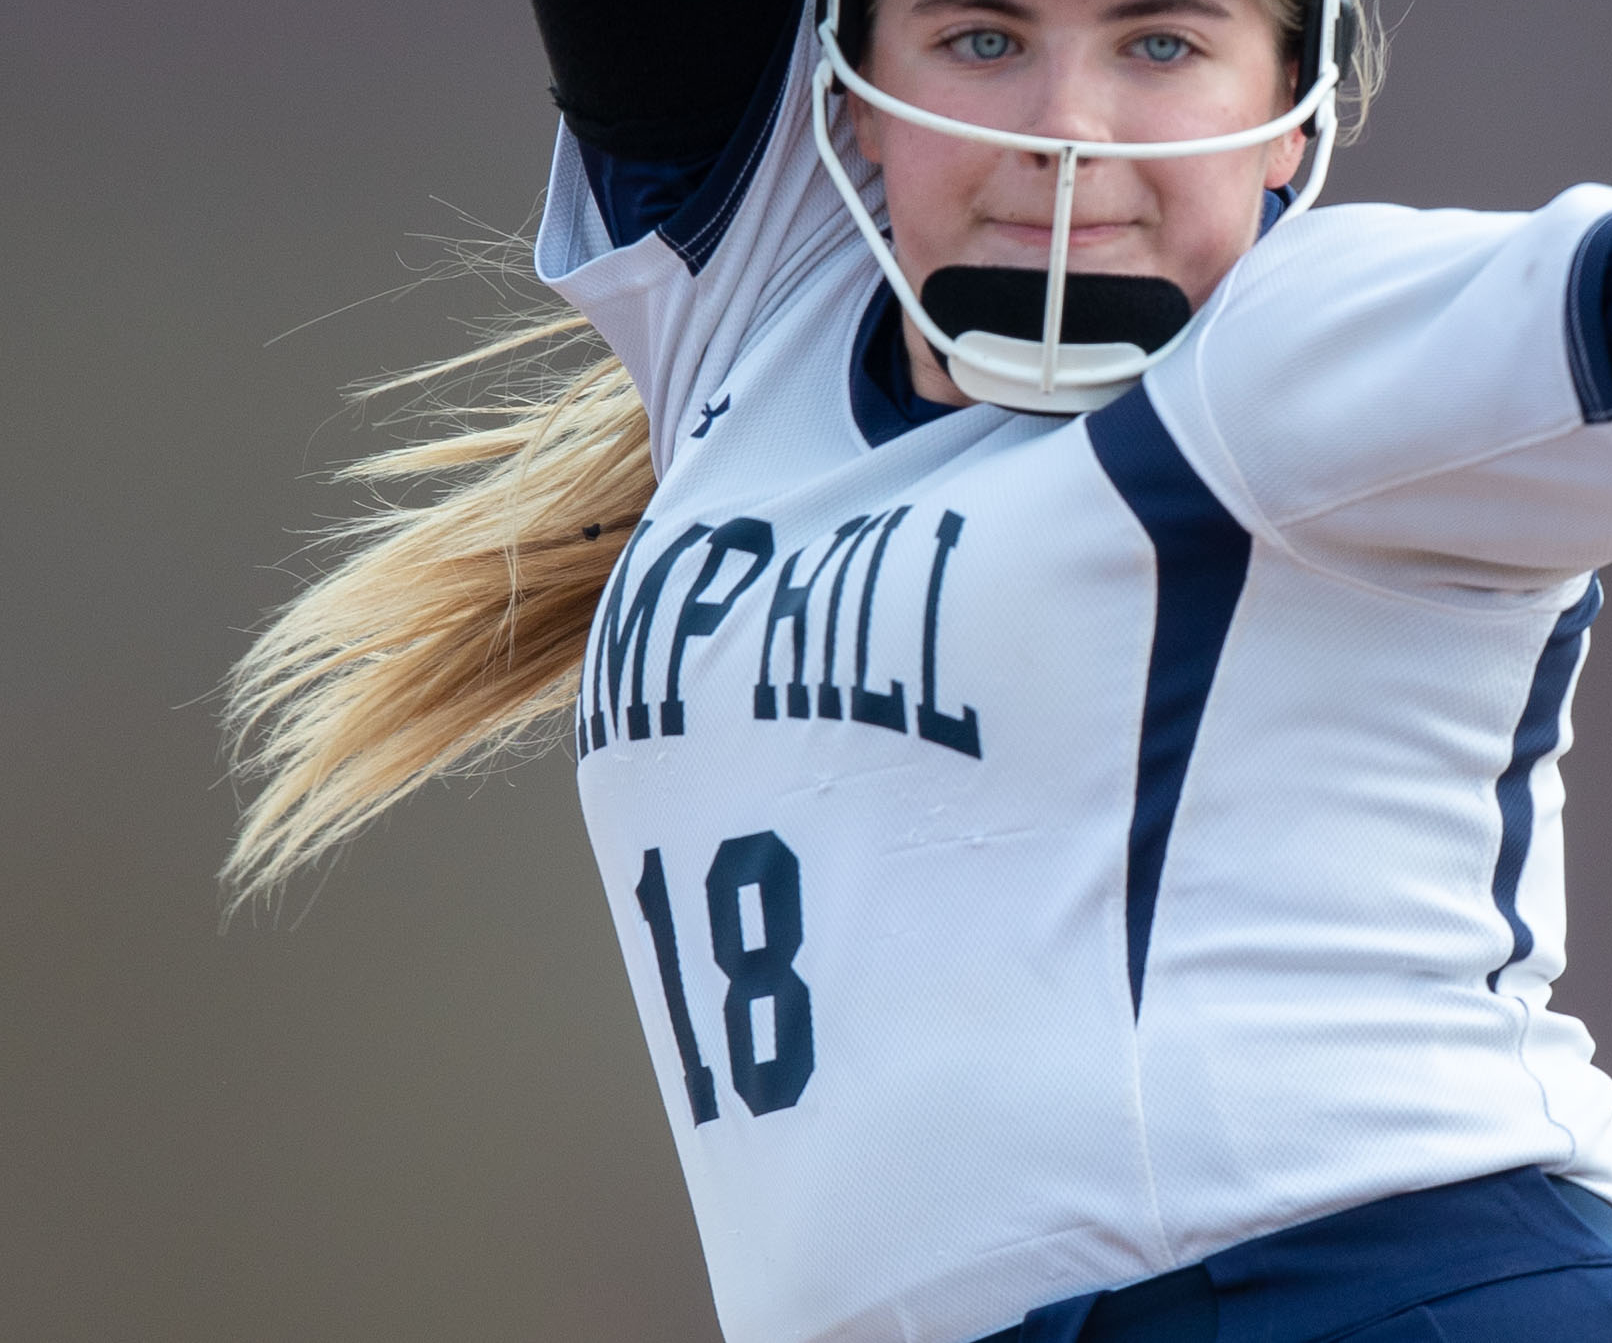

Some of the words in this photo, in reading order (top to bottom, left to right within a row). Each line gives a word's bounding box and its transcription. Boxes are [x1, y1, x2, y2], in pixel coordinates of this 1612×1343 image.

[577, 516, 775, 761] MP
[754, 505, 983, 760] HILL
[635, 830, 815, 1129] 18
